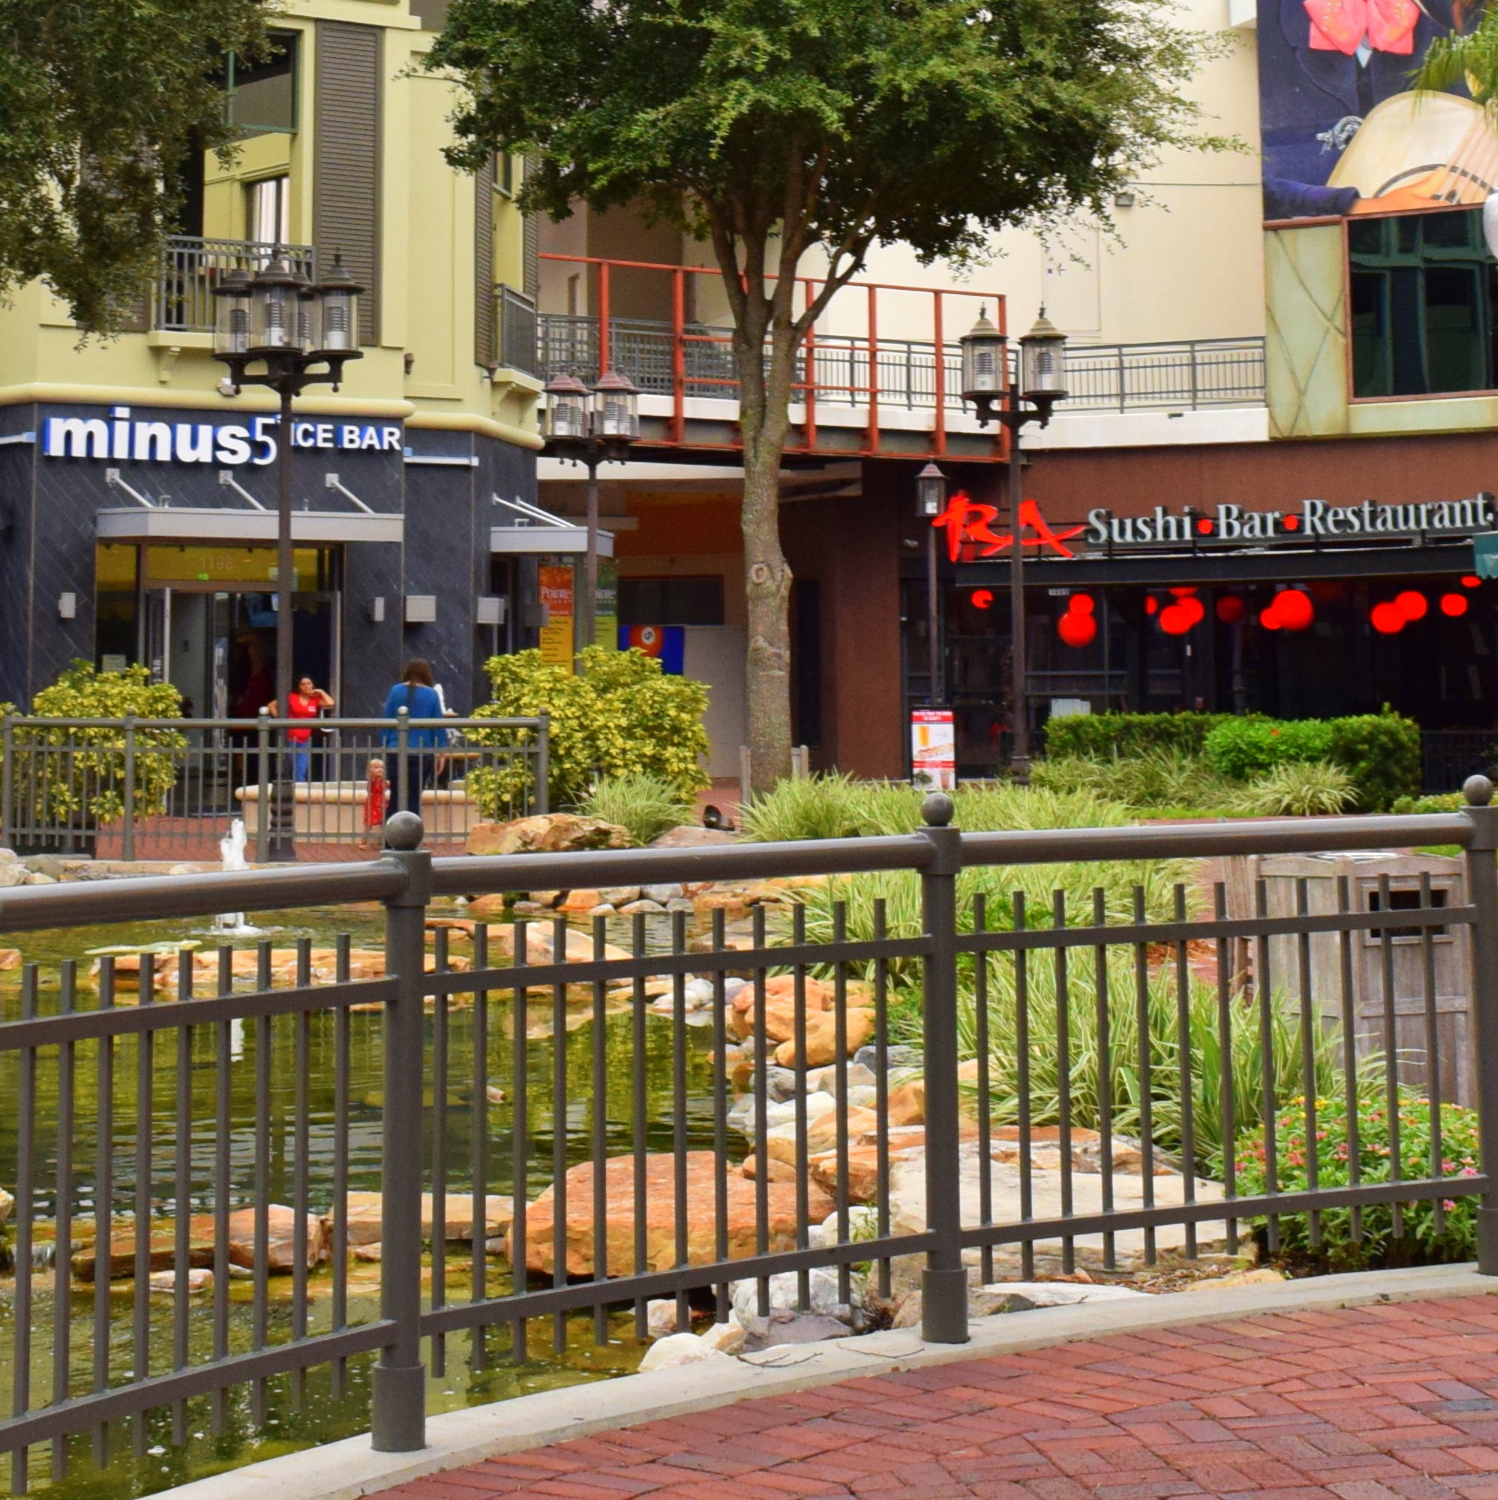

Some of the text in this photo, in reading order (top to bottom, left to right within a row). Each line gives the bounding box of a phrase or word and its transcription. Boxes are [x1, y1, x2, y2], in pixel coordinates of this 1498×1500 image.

[290, 422, 334, 448] ICE
[341, 425, 402, 450] BAR
[932, 492, 1489, 562] RA Sushi Bar Restaurant
